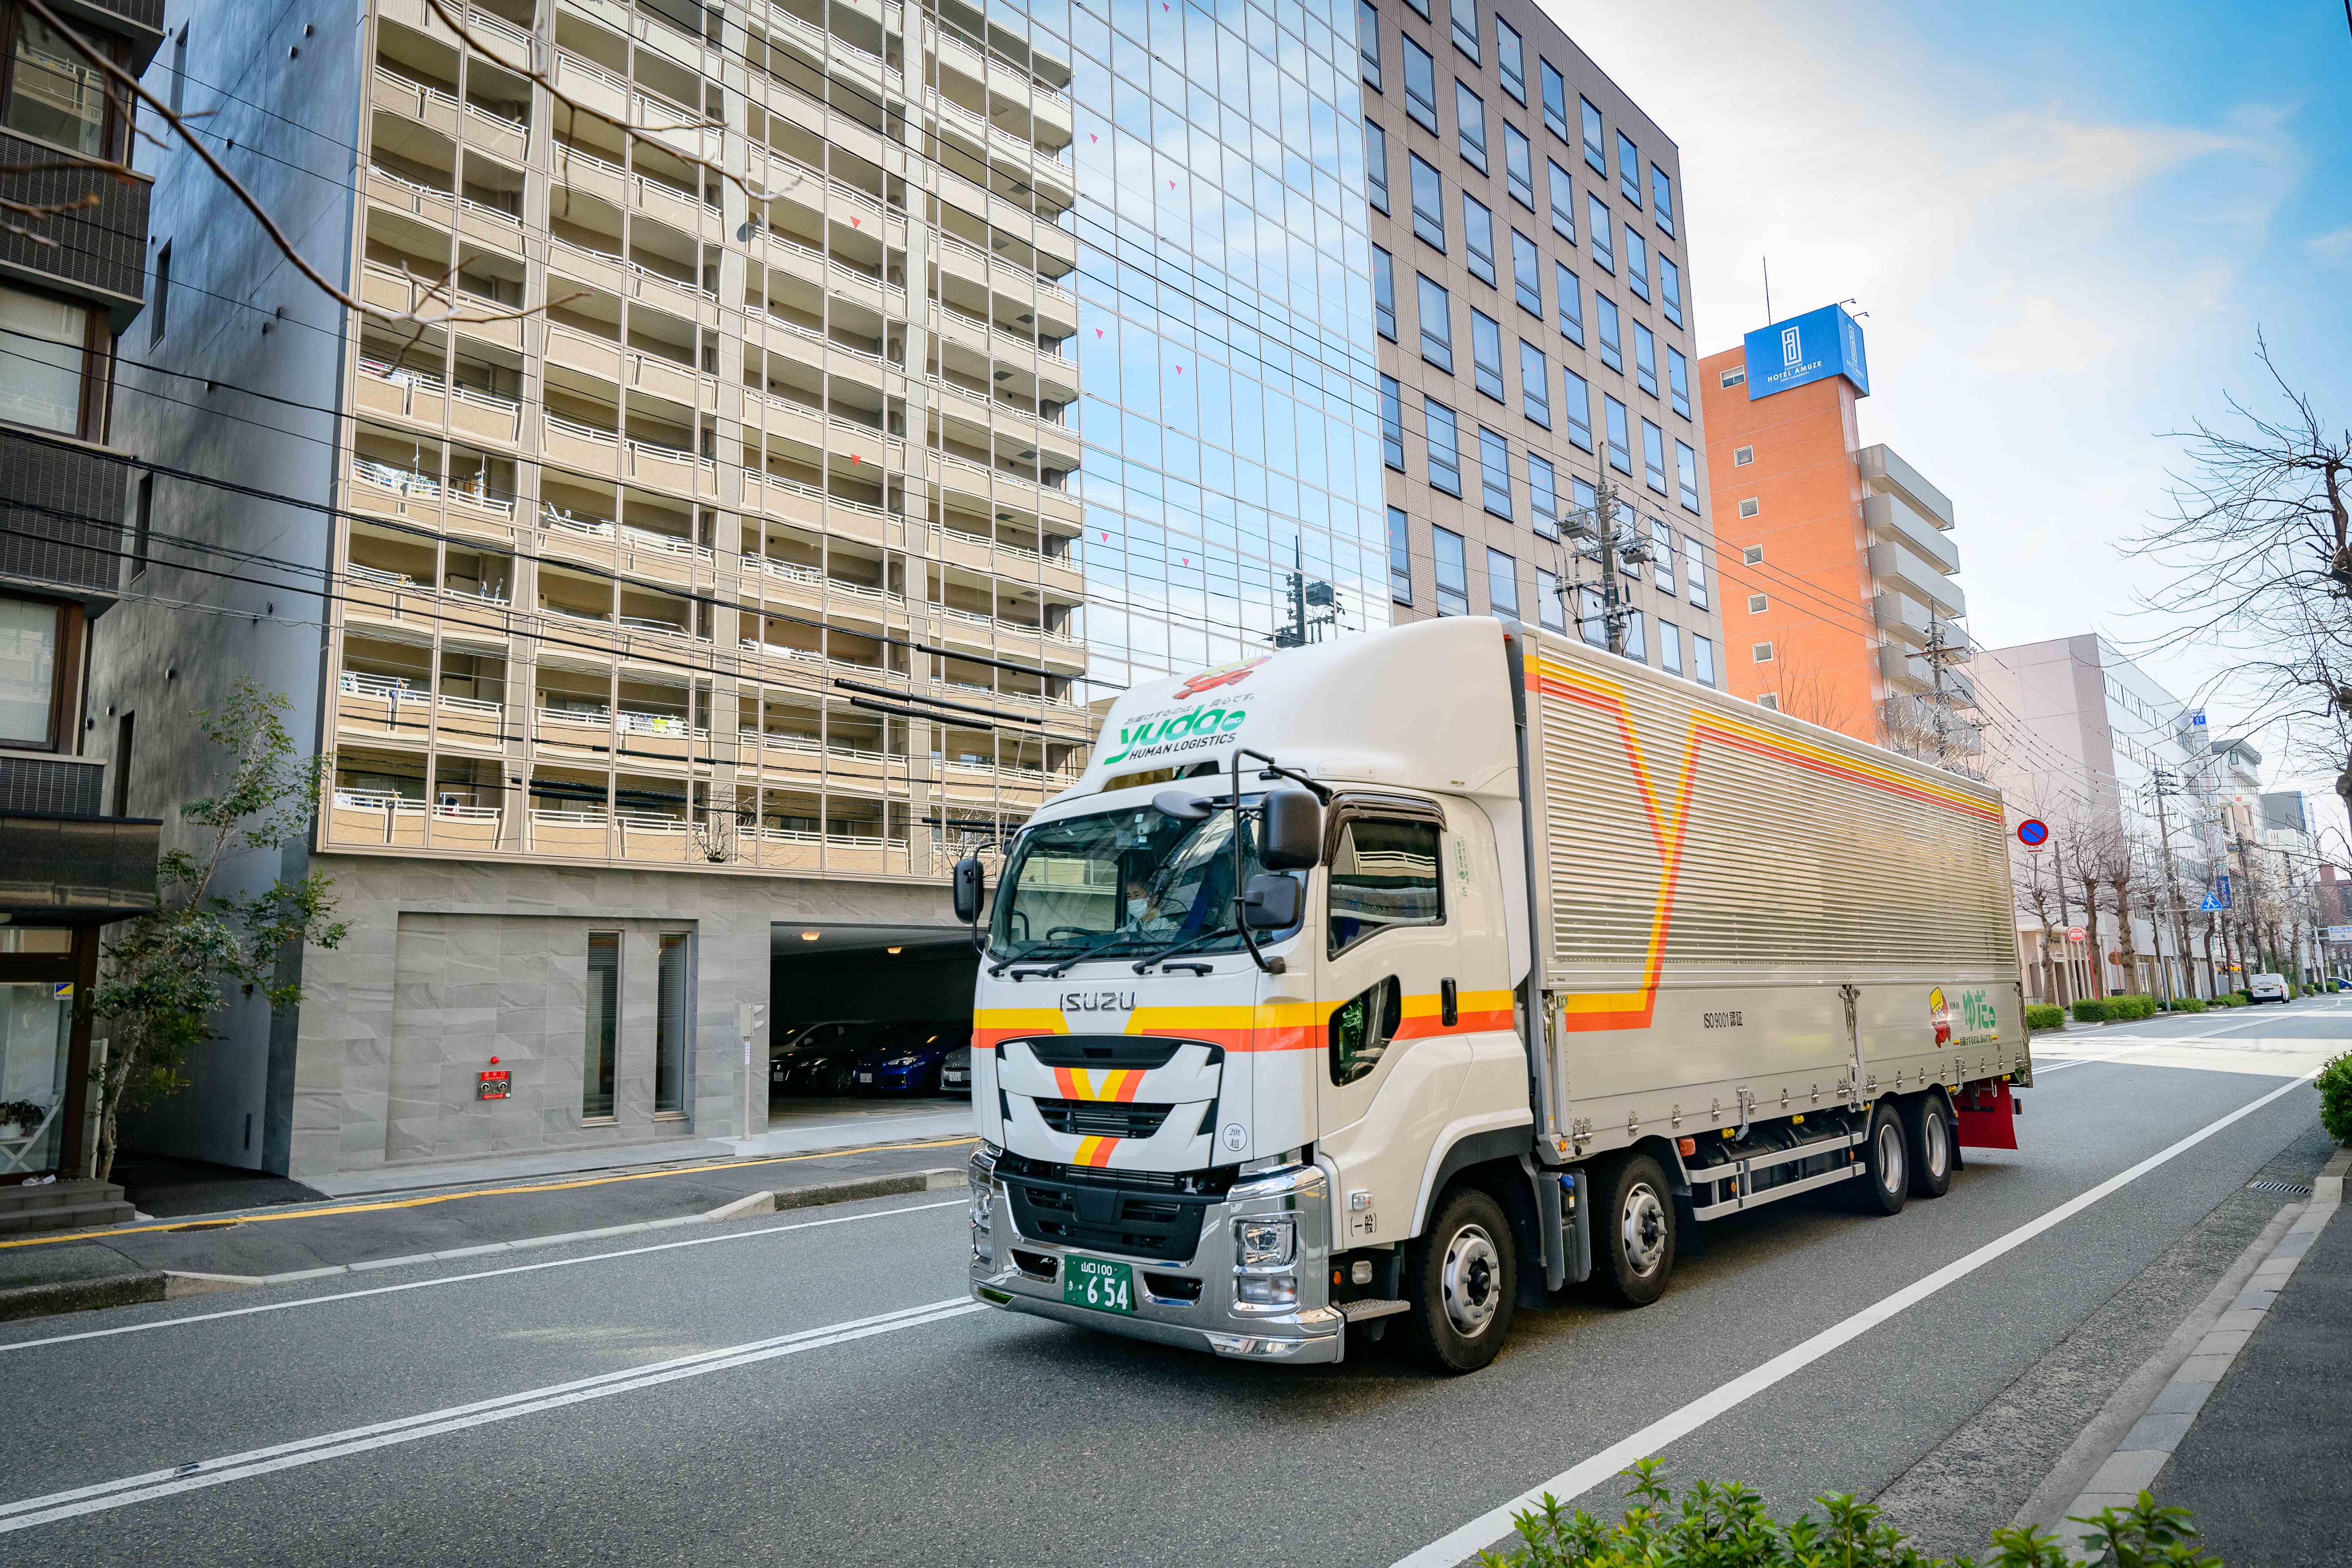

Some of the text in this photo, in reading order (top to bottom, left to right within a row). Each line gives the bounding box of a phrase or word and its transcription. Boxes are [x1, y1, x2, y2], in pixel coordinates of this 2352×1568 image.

[1767, 360, 1821, 382] HOTEL AMUZE
[1104, 705, 1227, 765] yuda
[1129, 733, 1237, 760] HUMAN LOGISTICS
[1060, 991, 1136, 1012] ISUZU
[1229, 1128, 1241, 1136] 20t
[1230, 1138, 1239, 1149] 超
